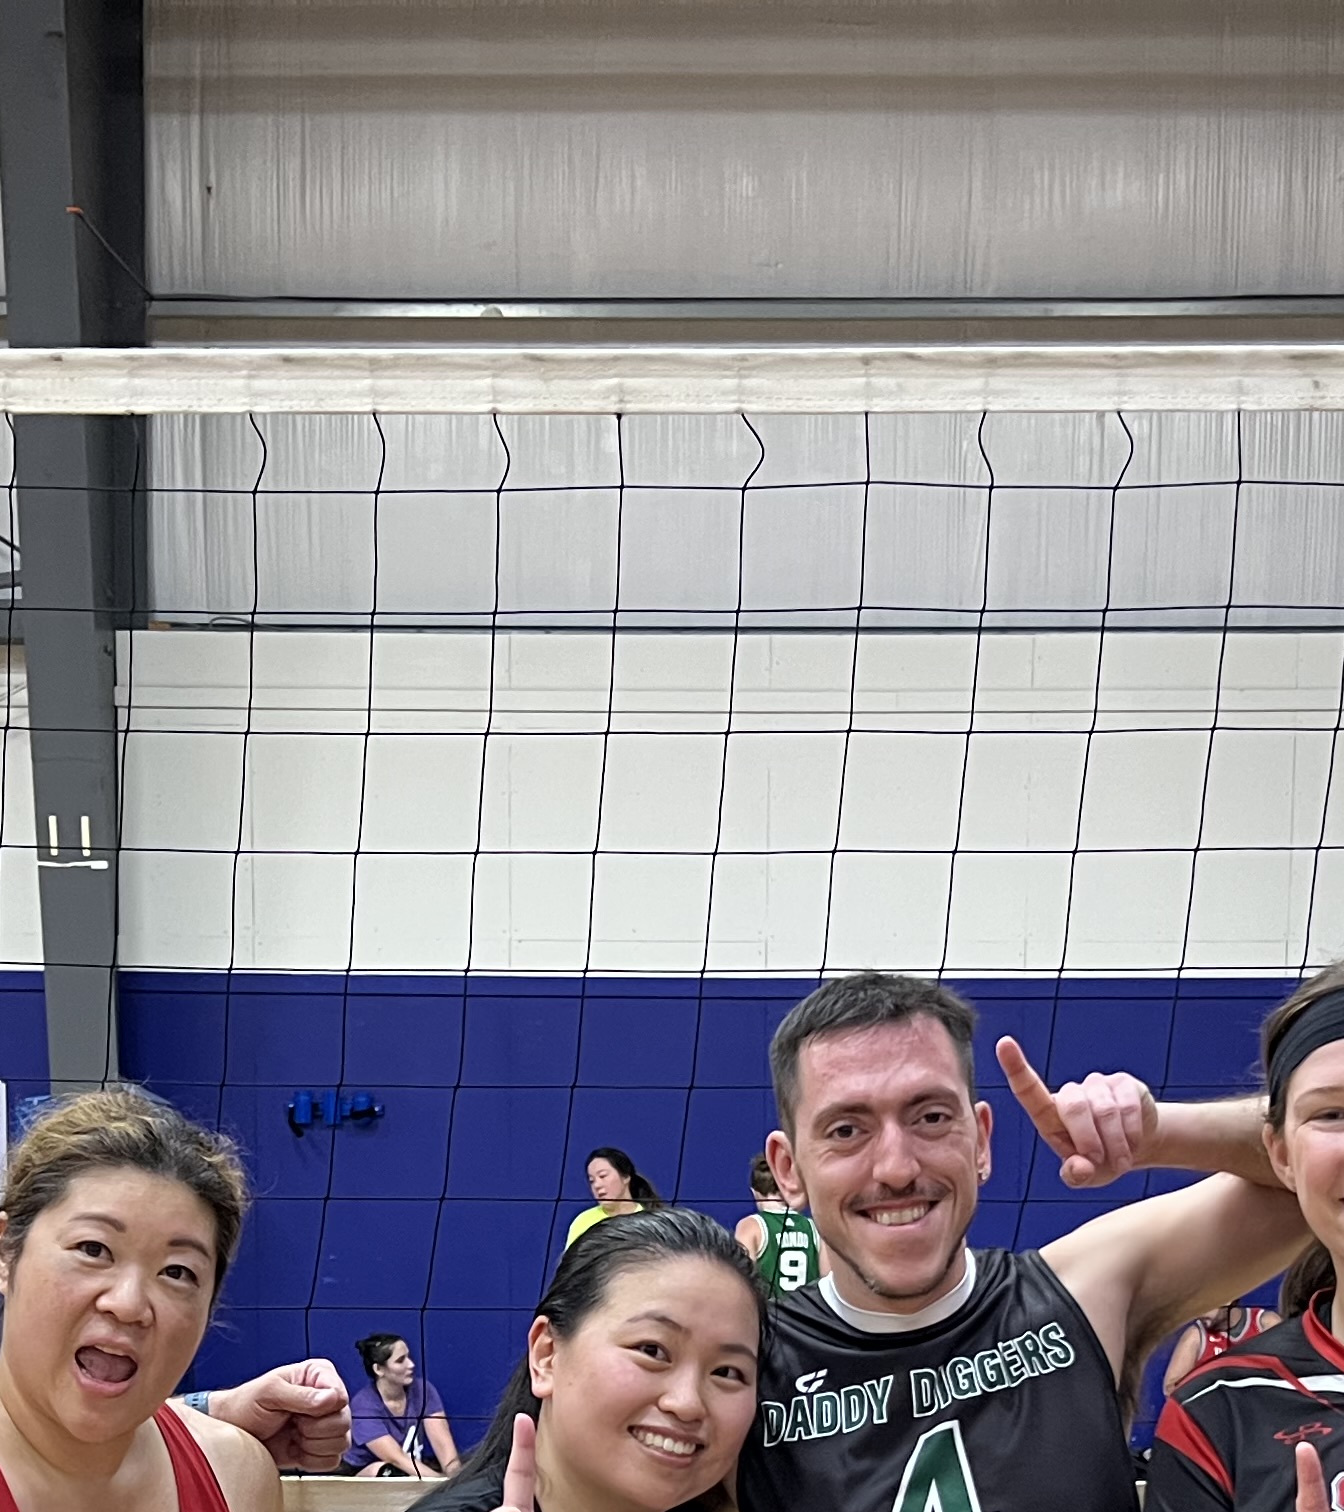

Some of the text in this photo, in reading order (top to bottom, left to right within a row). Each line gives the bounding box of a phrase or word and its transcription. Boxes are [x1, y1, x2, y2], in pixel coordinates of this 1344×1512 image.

[779, 1250, 807, 1291] 9
[761, 1322, 1076, 1447] DADDY DIGGERS
